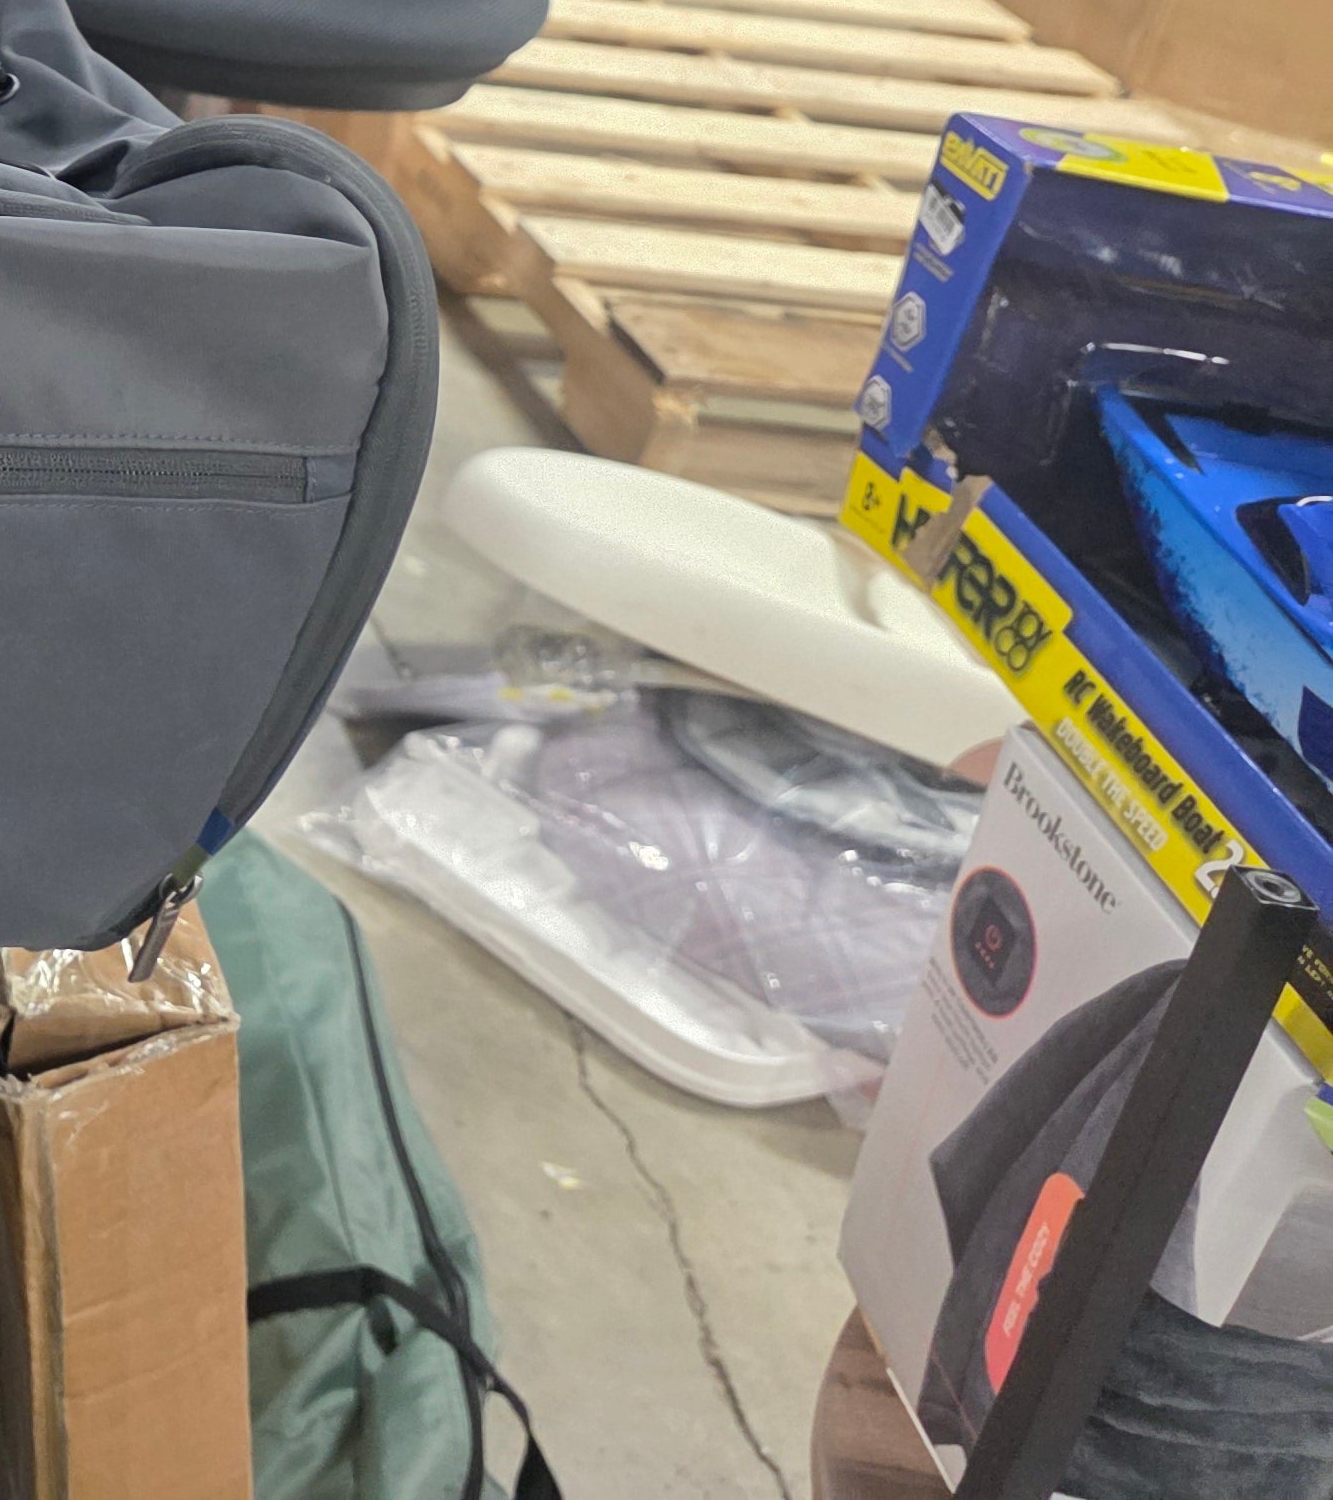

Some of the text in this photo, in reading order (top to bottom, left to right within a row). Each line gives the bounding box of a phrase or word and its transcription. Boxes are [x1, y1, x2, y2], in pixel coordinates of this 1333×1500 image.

[1002, 761, 1118, 915] Brookstone
[1056, 717, 1170, 852] DOUBLE THE SPEED
[1063, 669, 1096, 705] RC
[1086, 693, 1183, 805] Wakeboard
[1171, 794, 1225, 855] Boat
